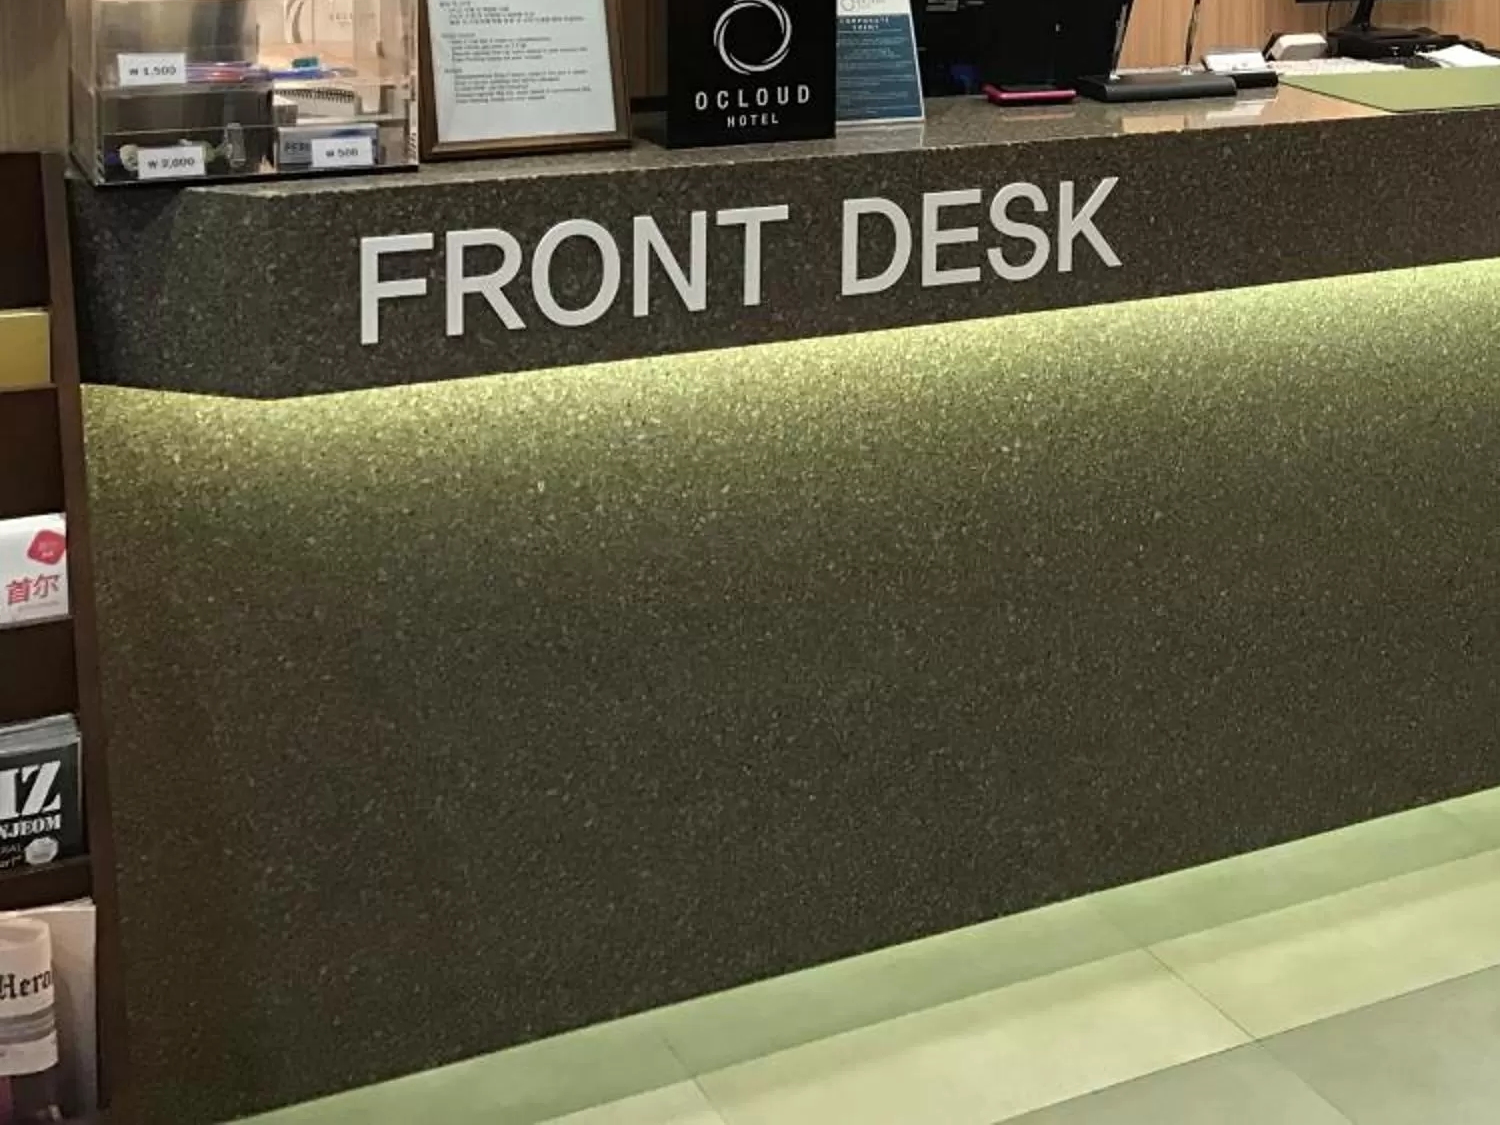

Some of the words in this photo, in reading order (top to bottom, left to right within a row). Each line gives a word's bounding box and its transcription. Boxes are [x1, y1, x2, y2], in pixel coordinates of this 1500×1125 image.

[695, 84, 809, 110] OCLOUD
[727, 112, 779, 127] HOTEL
[360, 204, 789, 345] FRONT
[842, 176, 1122, 297] DESK
